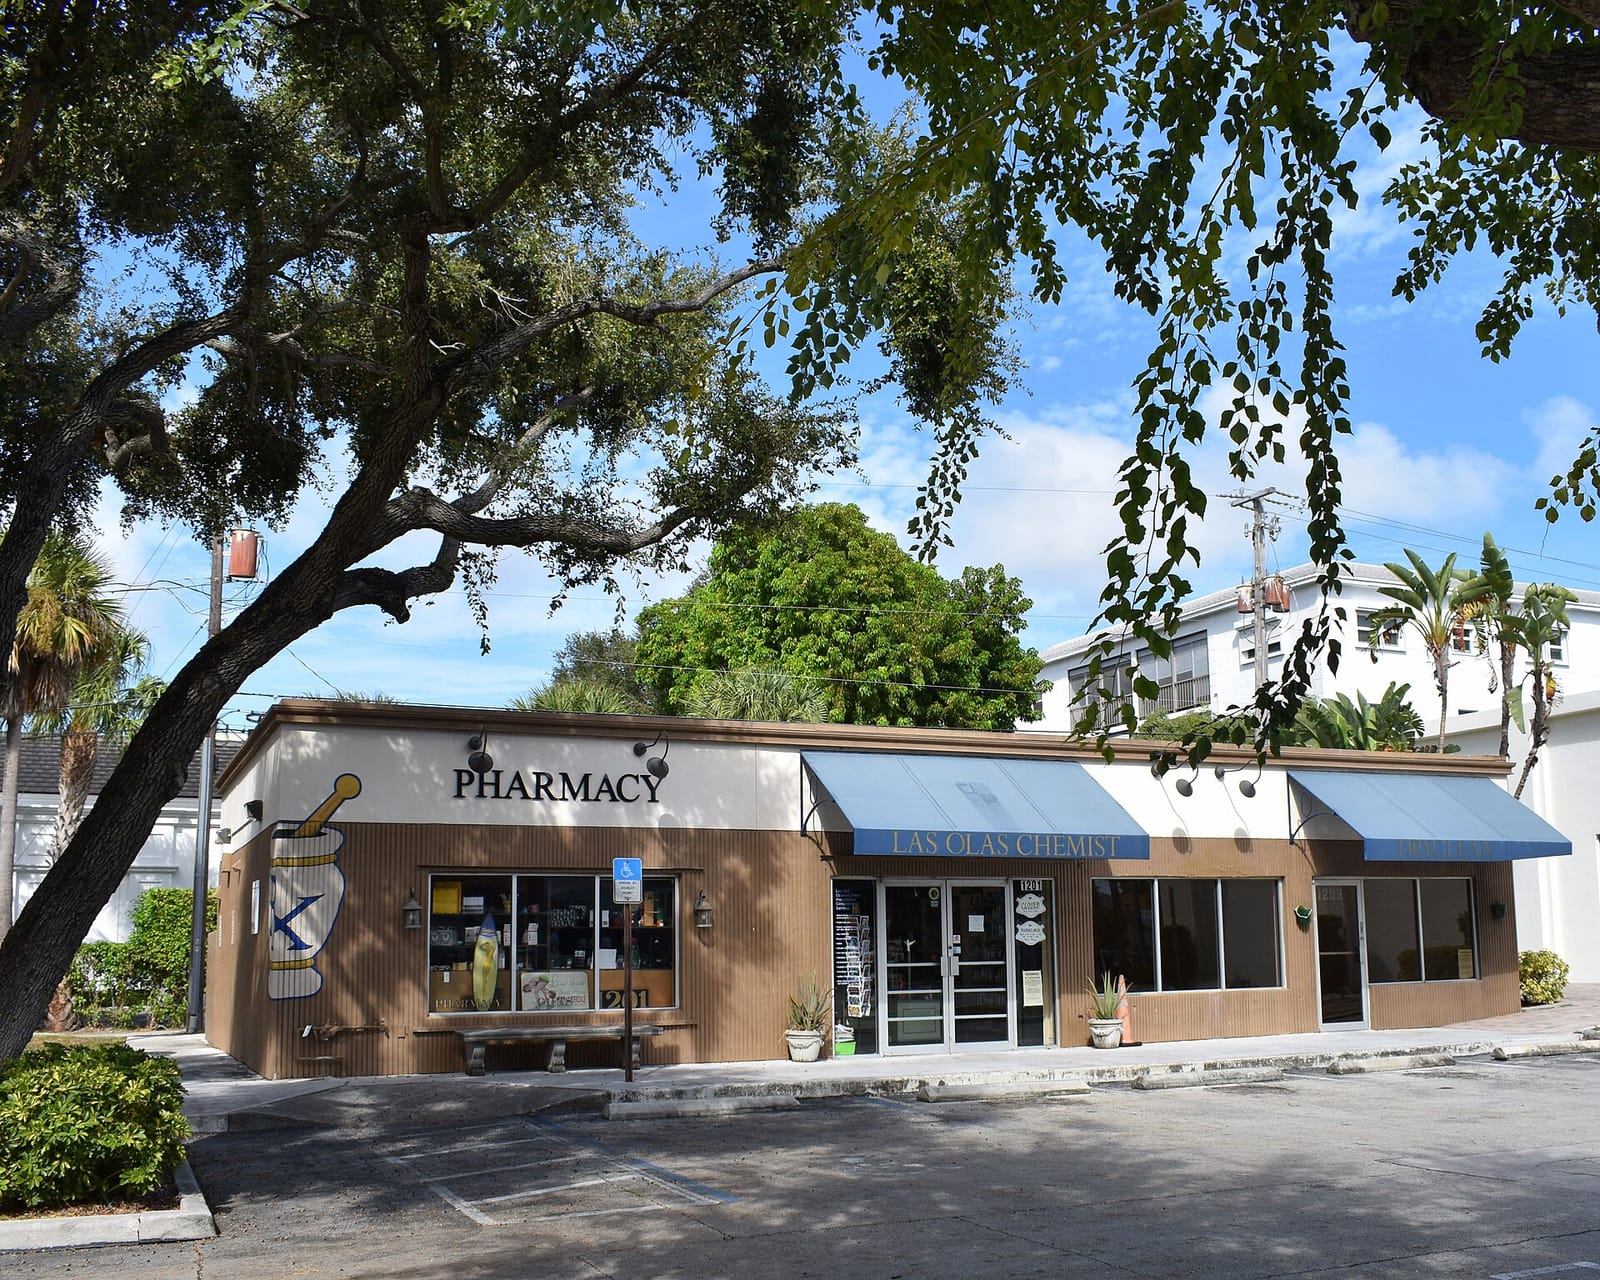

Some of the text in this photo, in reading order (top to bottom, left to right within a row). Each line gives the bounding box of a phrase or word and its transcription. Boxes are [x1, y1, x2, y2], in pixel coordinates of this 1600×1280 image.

[453, 769, 664, 802] PHARMACY
[892, 831, 1120, 857] LAS OLAS CHEMIST
[1021, 880, 1042, 891] 1201
